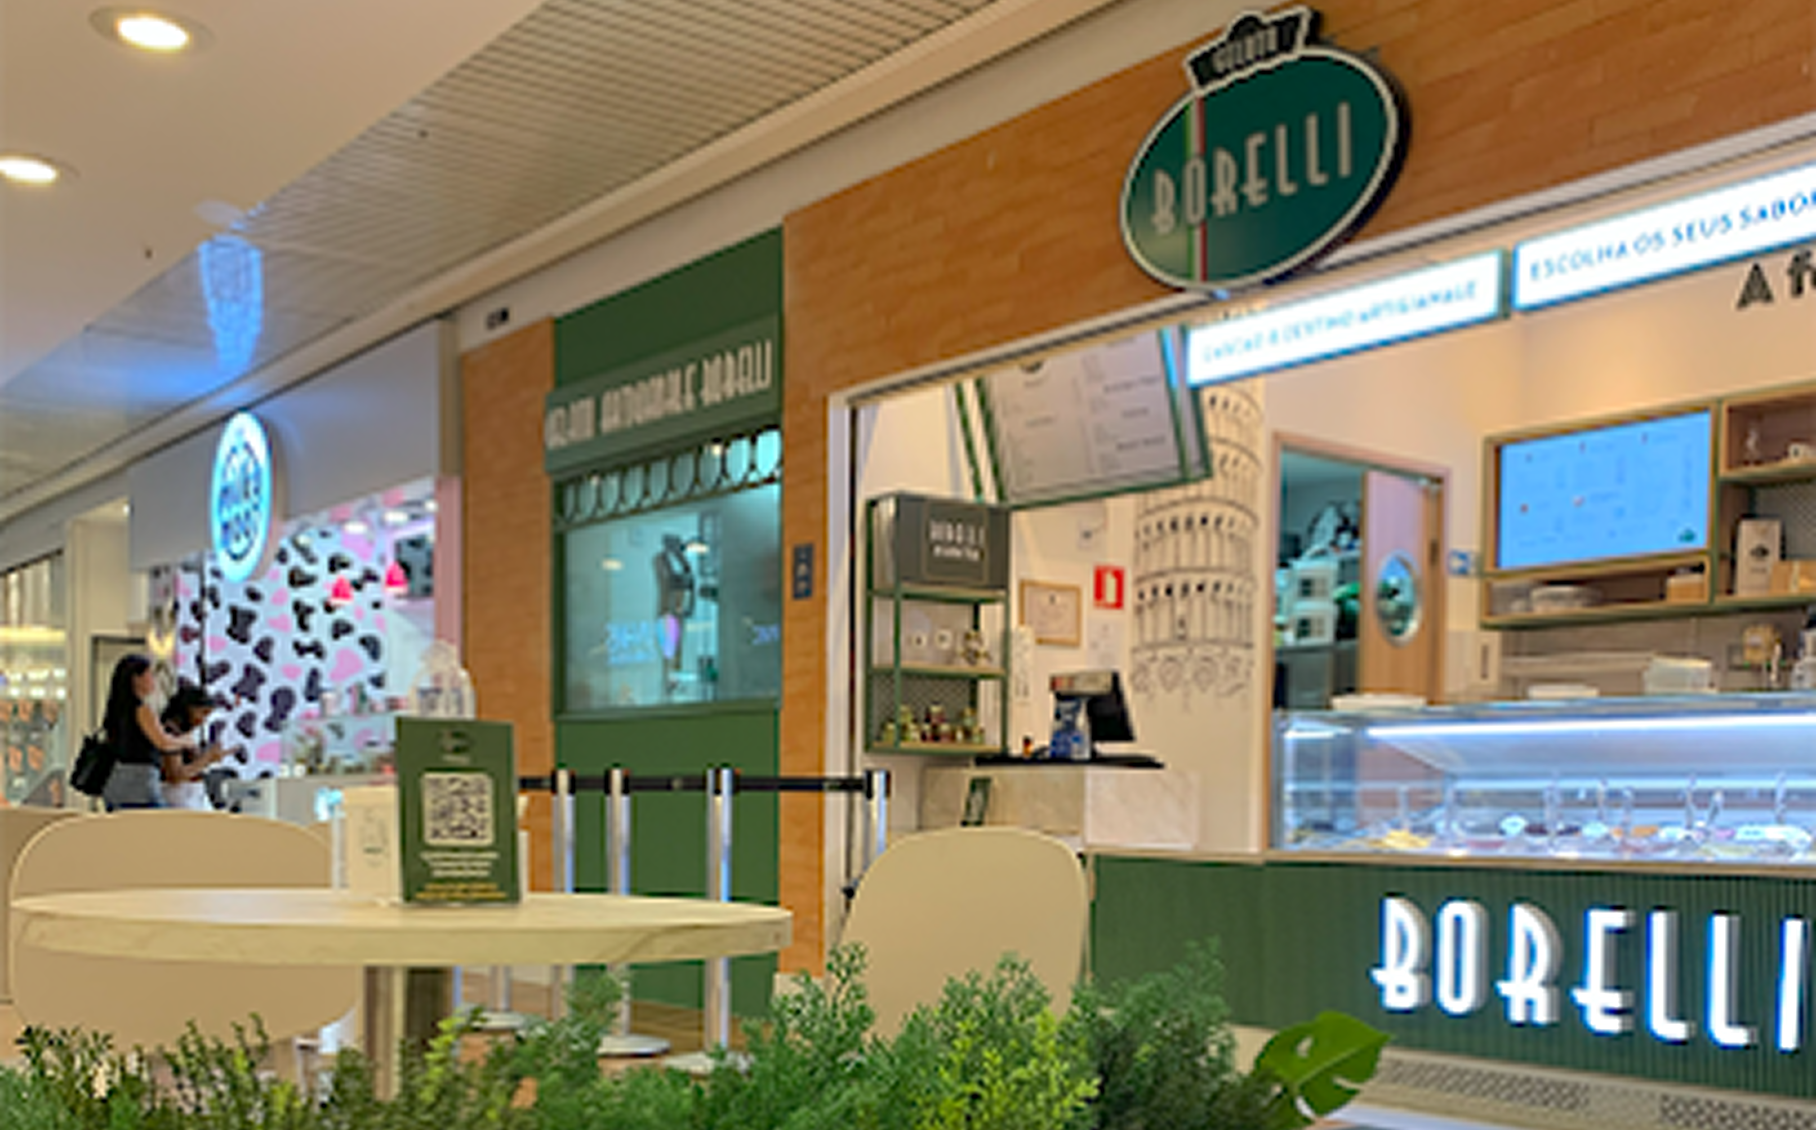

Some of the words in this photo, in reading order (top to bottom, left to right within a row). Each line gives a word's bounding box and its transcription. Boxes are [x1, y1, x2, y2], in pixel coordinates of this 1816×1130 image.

[1152, 101, 1351, 236] BORELLI
[1529, 242, 1628, 282] ESCOLHA
[1633, 230, 1666, 256] OS
[1672, 212, 1733, 247] SEUS
[1736, 260, 1775, 311] A
[1787, 246, 1816, 299] f
[1368, 896, 1810, 1055] BORELLI
